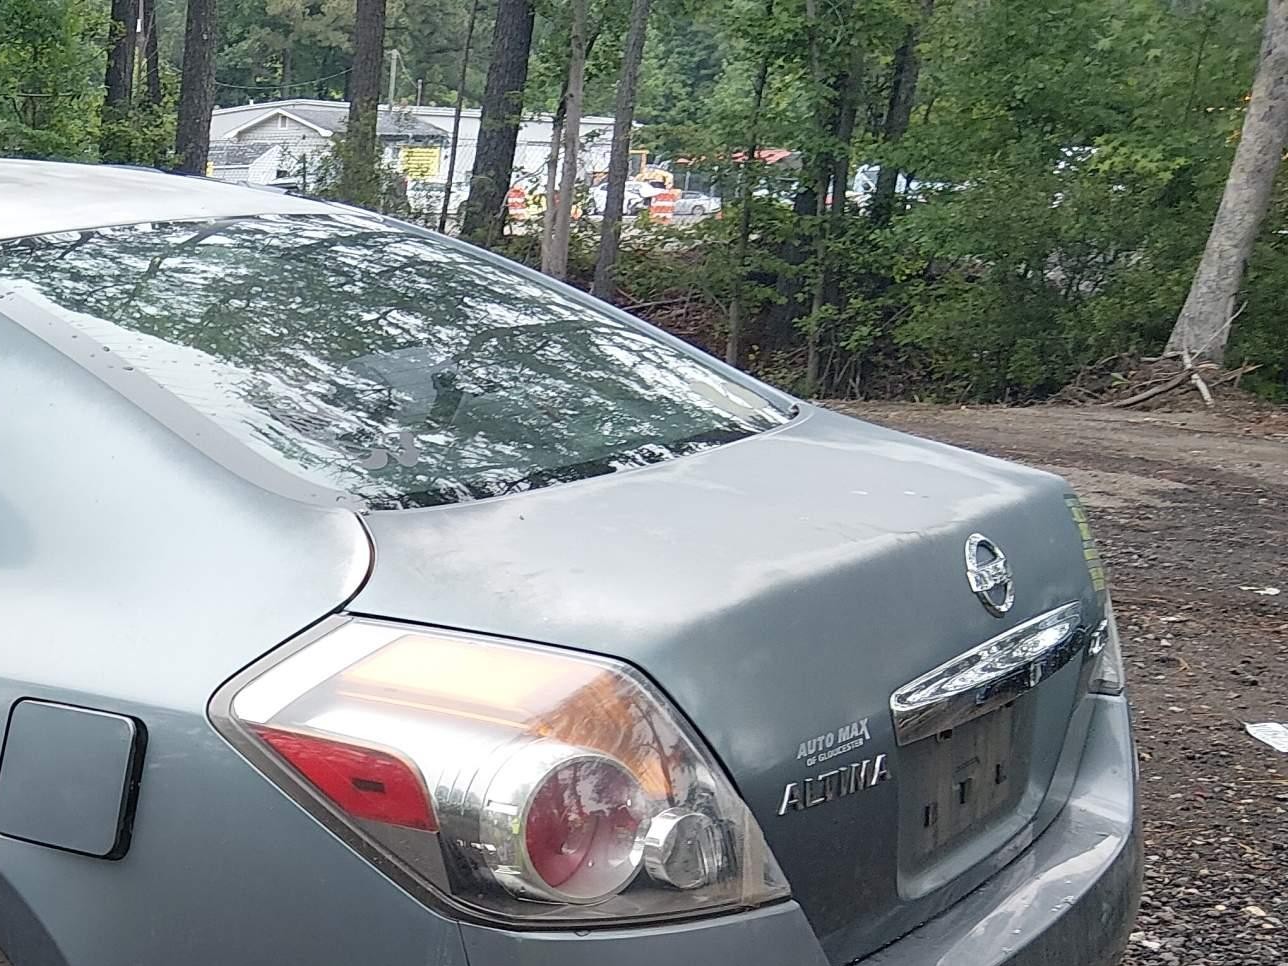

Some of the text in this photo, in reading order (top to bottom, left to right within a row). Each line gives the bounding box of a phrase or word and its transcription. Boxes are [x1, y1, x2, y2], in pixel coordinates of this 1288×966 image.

[797, 718, 870, 759] AUTO MAX
[806, 738, 864, 766] OF GLOUCESTER
[778, 753, 891, 816] ALTIMA
